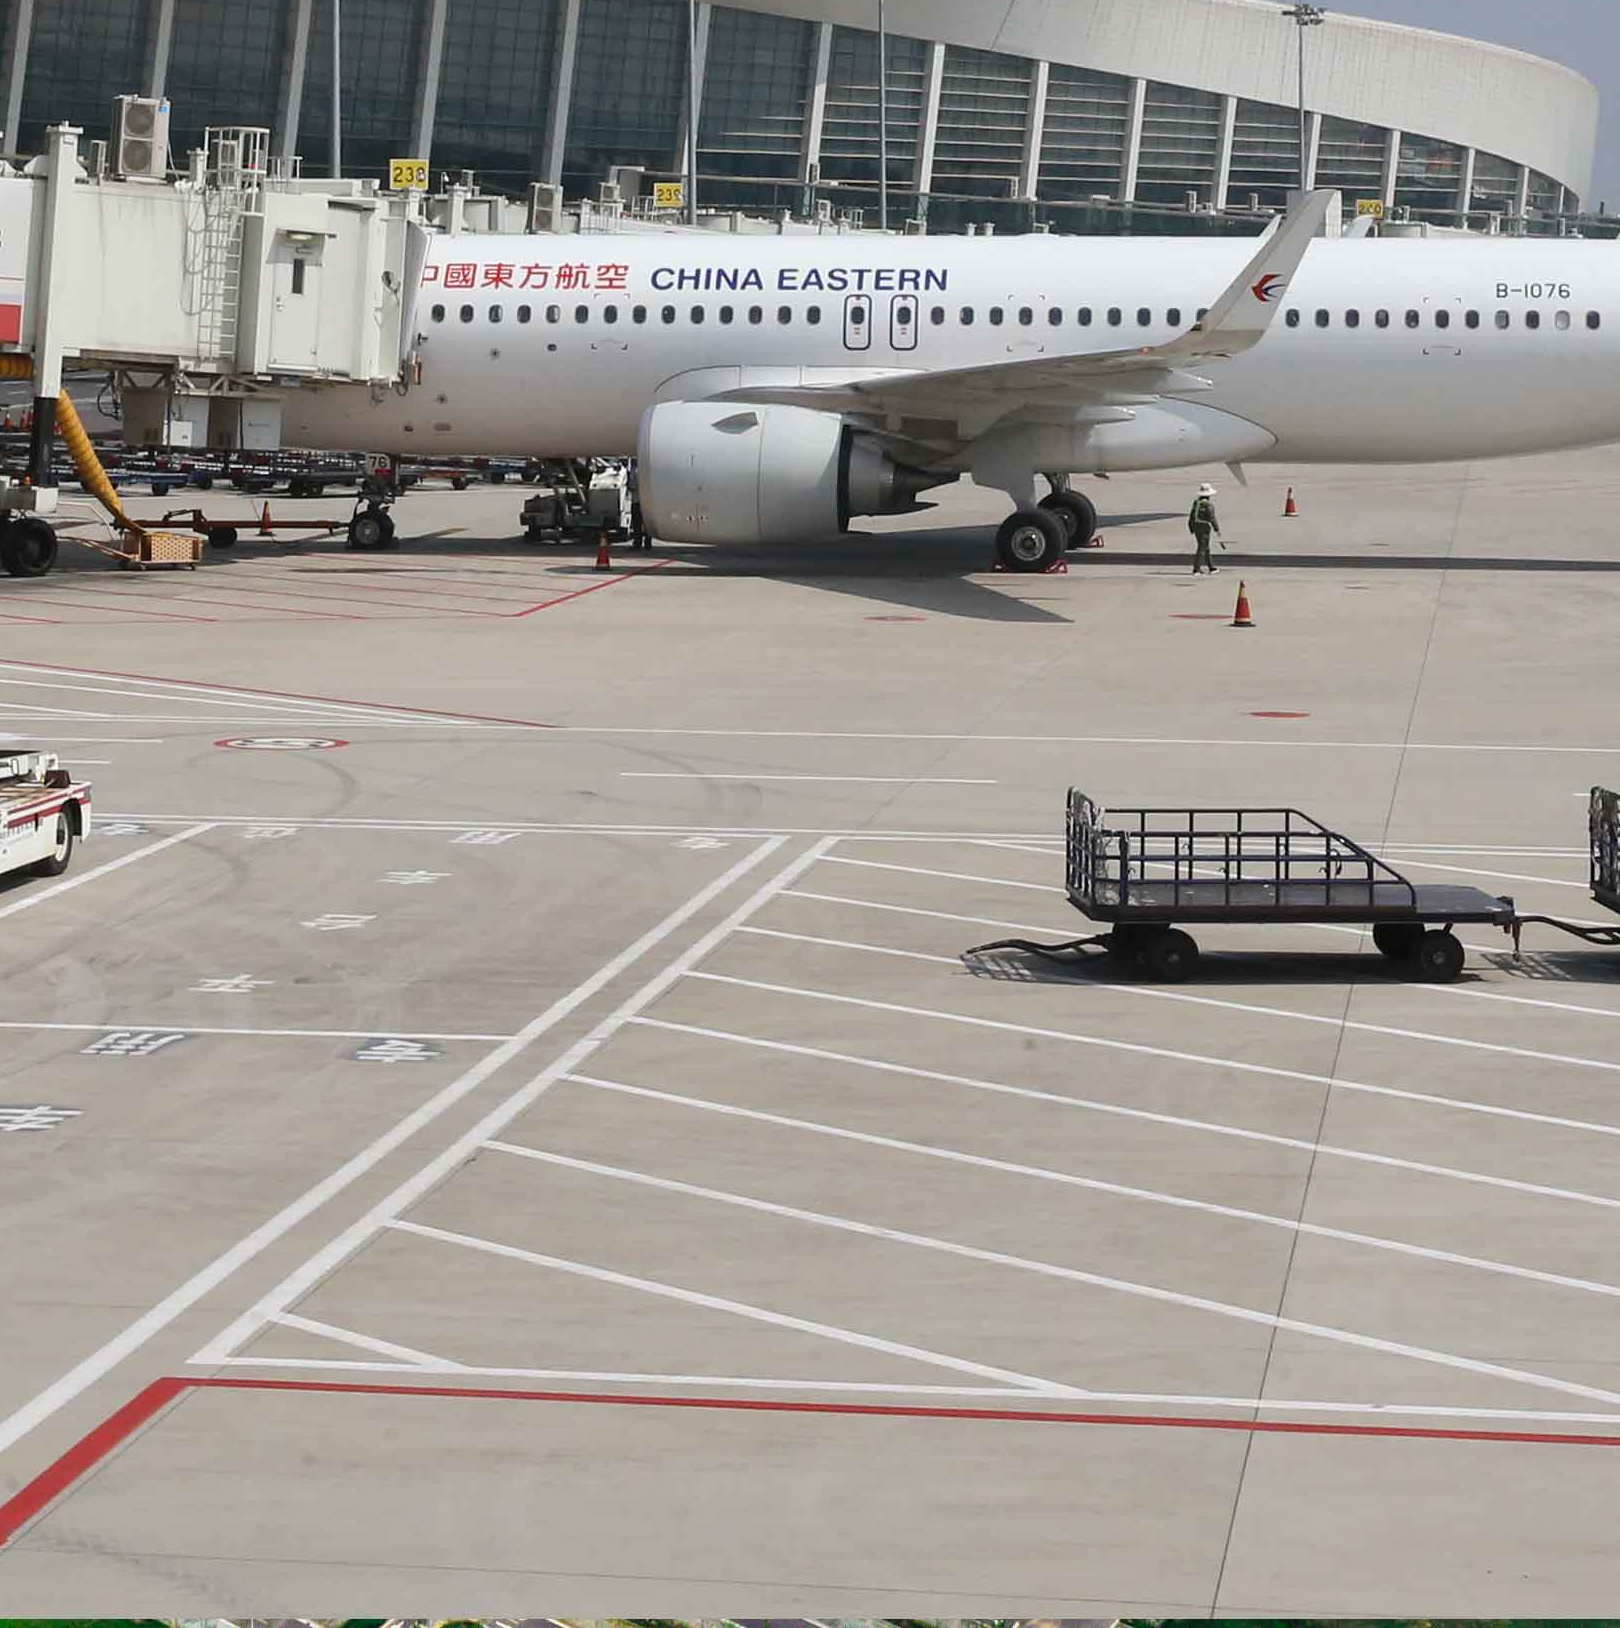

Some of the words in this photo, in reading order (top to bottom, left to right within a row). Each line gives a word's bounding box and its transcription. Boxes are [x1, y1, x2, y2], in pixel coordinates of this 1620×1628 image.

[650, 268, 764, 291] CHINA
[777, 268, 949, 291] EASTERN
[1495, 283, 1571, 299] B-1076
[368, 455, 388, 468] 76
